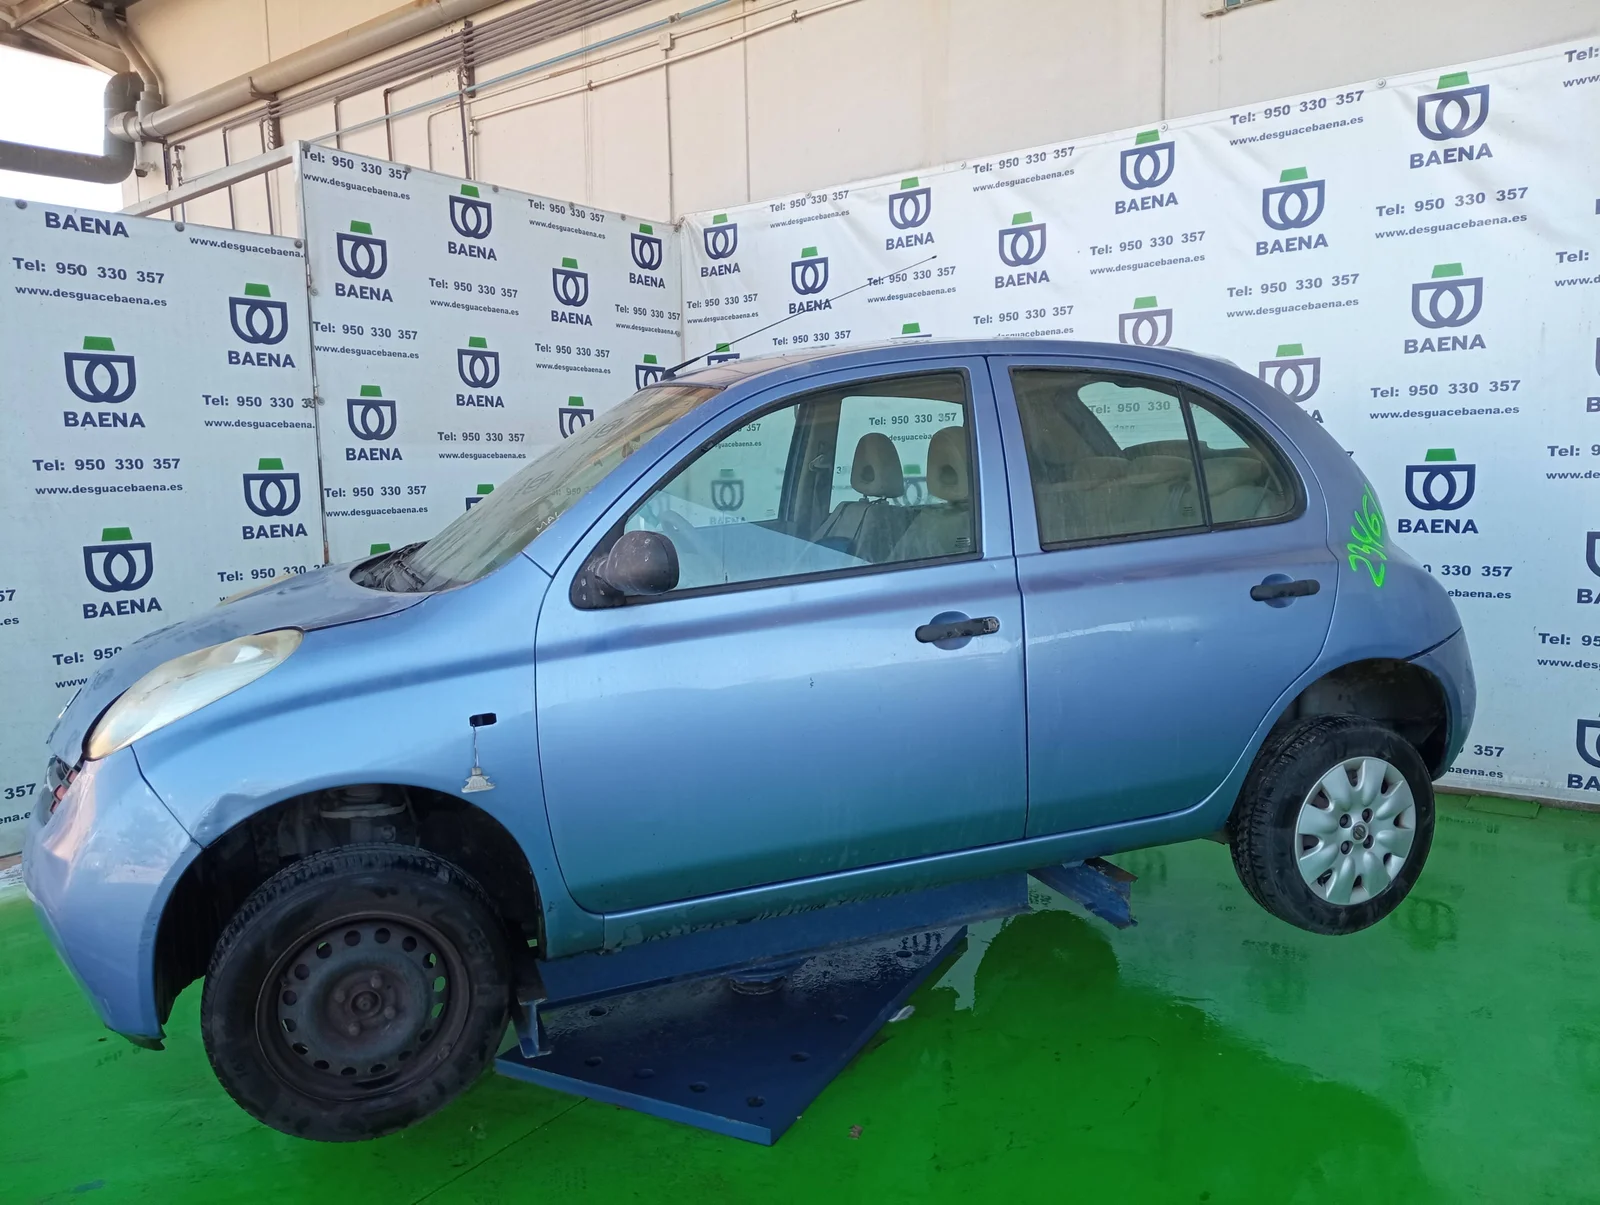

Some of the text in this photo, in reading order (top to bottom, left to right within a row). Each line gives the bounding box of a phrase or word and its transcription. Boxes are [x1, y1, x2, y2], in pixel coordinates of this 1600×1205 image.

[1564, 47, 1599, 62] Tel:
[1230, 90, 1364, 125] Tel: 950 330 357
[1230, 115, 1363, 146] www.desguacebaena.es
[973, 146, 1074, 173] Tel: 950 330 357
[1410, 143, 1493, 169] BAENA
[302, 149, 411, 180] Tel: 950 330 357
[303, 174, 410, 200] www.desguacebaena.es
[973, 168, 1074, 192] www.desguacebaena.es
[770, 190, 849, 212] Tel: 950 330 357
[1115, 192, 1178, 214] BAENA
[1376, 187, 1528, 216] Tel: 950 330 357
[528, 199, 604, 222] Tel: 950 330 357
[770, 209, 849, 228] www.desguacebaena.es
[45, 212, 129, 238] BAENA
[529, 219, 605, 239] www.desguacebaena.es
[1375, 214, 1527, 238] www.desguacebaena.es
[886, 232, 934, 250] BAENA
[1090, 231, 1205, 255] Tel: 950 330 357
[1256, 234, 1328, 255] BAENA
[448, 241, 497, 261] BAENA
[1556, 250, 1589, 263] Tel:
[13, 257, 164, 283] Tel: 950 330 357
[701, 263, 740, 277] BAENA
[1090, 255, 1205, 274] www.desguacebaena.es
[629, 273, 665, 288] BAENA
[868, 266, 955, 286] Tel: 950 330 357
[995, 270, 1050, 288] BAENA
[335, 283, 393, 302] BAENA
[429, 278, 517, 298] Tel: 950 330 357
[1227, 274, 1359, 297] Tel: 950 330 357
[15, 287, 167, 306] www.desguacebaena.es
[705, 298, 719, 307] 950
[725, 296, 739, 305] 330
[743, 293, 758, 302] 357
[868, 287, 956, 303] www.desguacebaena.es
[430, 300, 519, 315] www.desguacebaena.es
[615, 304, 682, 320] Tel: 950 330 357
[789, 298, 832, 314] BAENA
[1227, 299, 1359, 317] www.desguacebaena.es
[551, 310, 592, 326] BAENA
[687, 312, 758, 323] www.desguacebaena.es
[973, 305, 1073, 324] Tel: 950 330 357
[313, 321, 417, 340] Tel: 950 330 357
[773, 330, 851, 345] Tel: 950 330 357
[314, 344, 419, 359] www.desguacebaena.es
[535, 343, 610, 358] Tel: 950 330 357
[1404, 334, 1486, 354] BAENA
[228, 351, 295, 368] BAENA
[536, 363, 611, 374] www.desguacebaena.es
[1371, 380, 1520, 398] Tel: 950 330 357
[202, 395, 228, 405] Tel:
[237, 396, 262, 407] 950
[270, 397, 293, 408] 330
[456, 394, 504, 408] BAENA
[1089, 405, 1110, 414] Tel:
[1118, 403, 1140, 412] 950
[1148, 401, 1170, 411] 330
[64, 412, 145, 427] BAENA
[869, 413, 956, 425] Tel: 950 330 357
[1370, 407, 1519, 419] www.desguacebaena.es
[205, 418, 315, 430] www.desguacebaena.
[747, 423, 761, 431] 357
[437, 432, 524, 442] Tel: 950 330 357
[346, 448, 402, 460] BAENA
[439, 452, 526, 460] www.desguacebaena.es
[1547, 445, 1580, 456] Tel:
[32, 459, 180, 471] Tel: 950 330 357
[35, 484, 183, 495] www.desguacebaena.es
[324, 486, 426, 498] Tel: 950 330 357
[326, 507, 428, 517] www.desguacebaena.es
[242, 523, 308, 539] BAENA
[1398, 519, 1478, 533] BAENA
[217, 571, 243, 582] Tel:
[251, 568, 275, 579] 950
[1442, 565, 1471, 576] 330
[1482, 566, 1512, 577] 357
[0, 589, 16, 601] 57
[83, 597, 162, 619] BAENA
[1539, 633, 1600, 646] Tel: 95
[53, 652, 84, 665] Tel:
[1474, 745, 1504, 757] 357
[4, 783, 36, 799] 357
